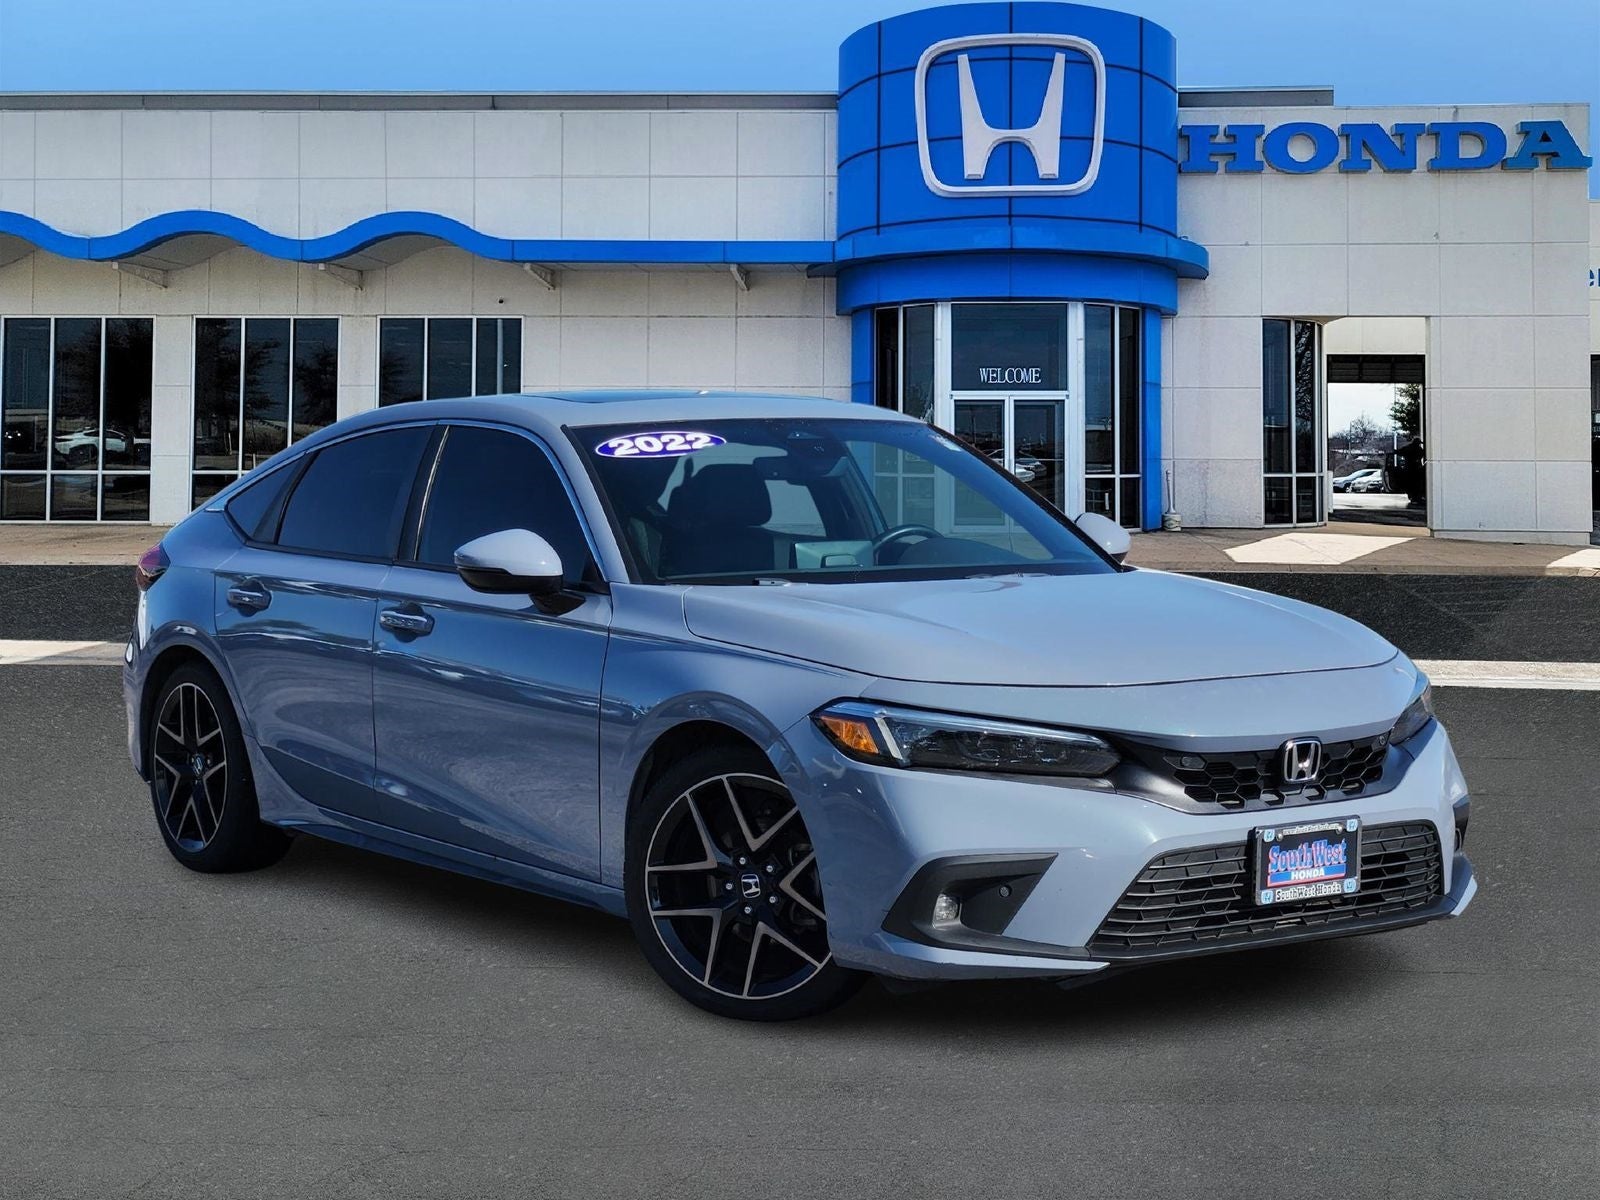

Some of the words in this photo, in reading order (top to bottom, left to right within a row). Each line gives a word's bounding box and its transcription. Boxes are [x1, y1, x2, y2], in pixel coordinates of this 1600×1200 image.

[1179, 121, 1593, 174] HONDA
[979, 367, 1041, 384] WELCOME
[608, 433, 711, 456] 2022
[1291, 868, 1325, 880] HONDA
[1316, 881, 1342, 896] Honda
